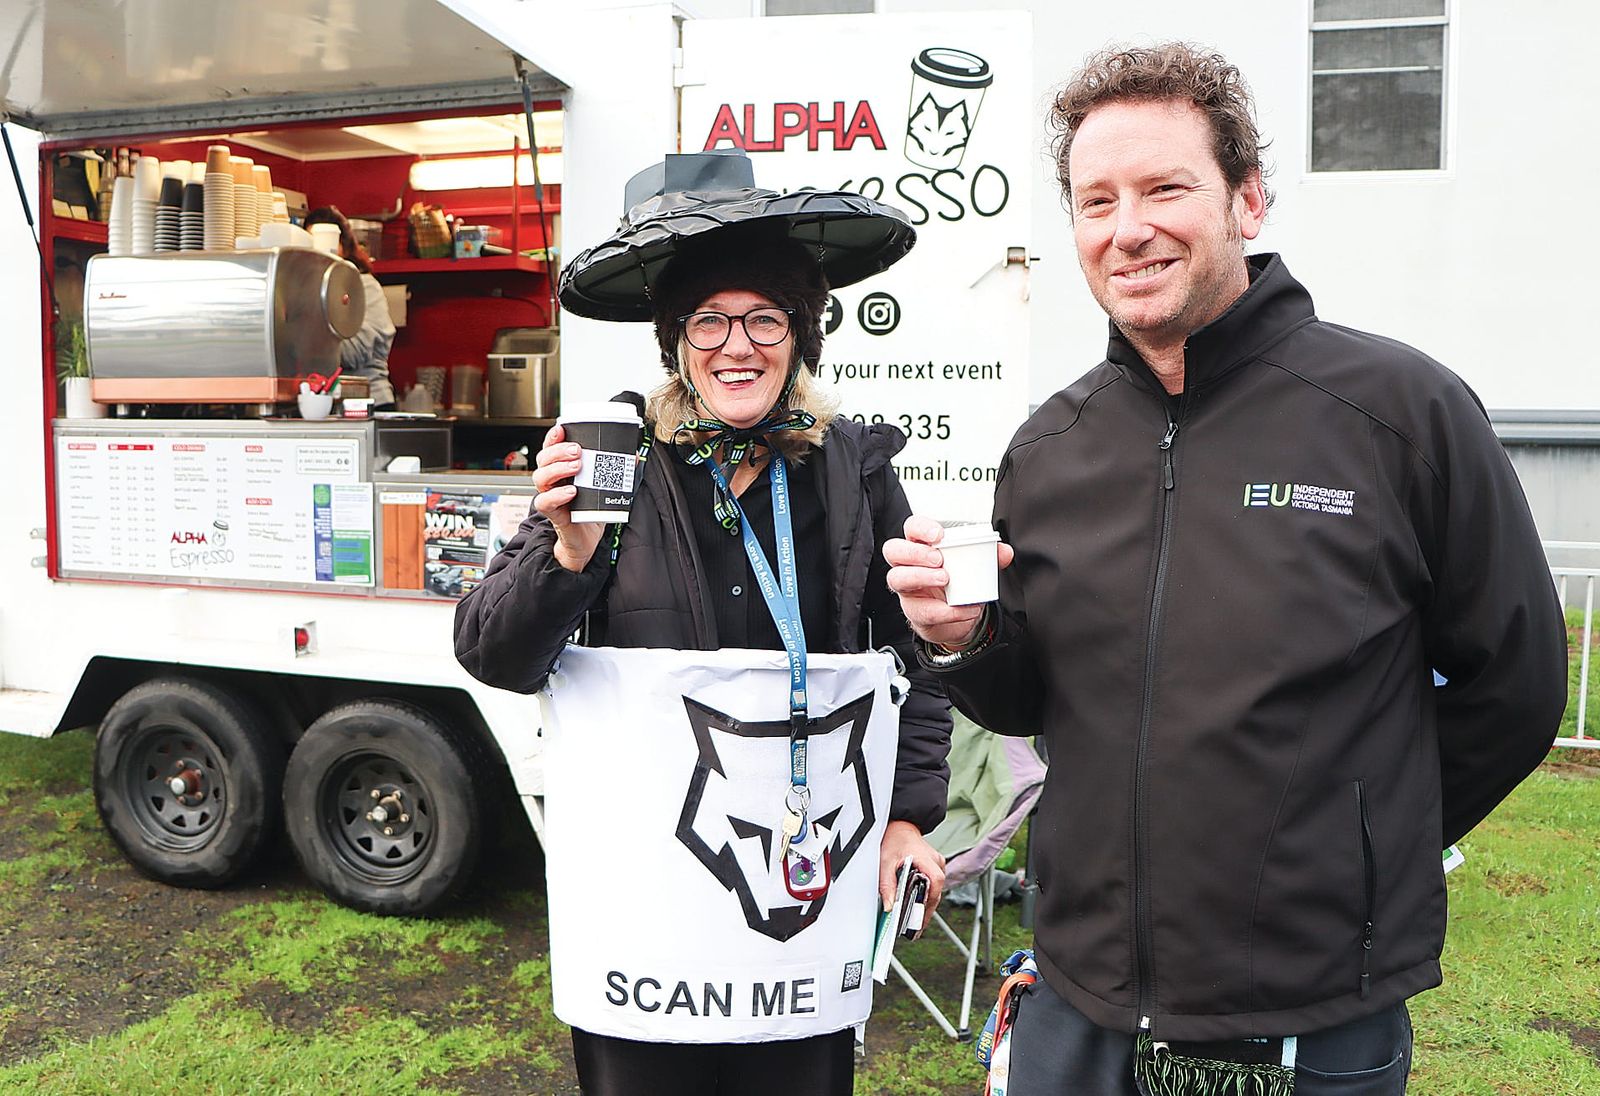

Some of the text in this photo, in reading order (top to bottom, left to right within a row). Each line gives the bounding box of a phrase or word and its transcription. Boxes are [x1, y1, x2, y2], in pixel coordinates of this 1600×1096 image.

[703, 100, 887, 152] ALPHA
[832, 364, 880, 384] your
[888, 361, 934, 380] next
[943, 361, 1002, 380] event
[774, 458, 783, 484] Action
[1243, 483, 1291, 507] IEU
[1292, 493, 1354, 507] EDUCATION UNION
[1293, 484, 1355, 500] INDEPENDENT
[777, 496, 786, 515] Love
[1291, 500, 1353, 516] VICTORIA TASMANIA
[424, 512, 473, 531] WIN
[171, 531, 208, 545] ALPHA
[169, 547, 235, 570] Espresso
[782, 537, 792, 564] Action
[748, 541, 760, 561] Love
[760, 571, 775, 599] Action
[785, 576, 794, 598] Love
[780, 618, 792, 640] Love
[788, 640, 796, 650] In
[791, 651, 801, 683] Action
[605, 970, 816, 1017] SCAN ME
